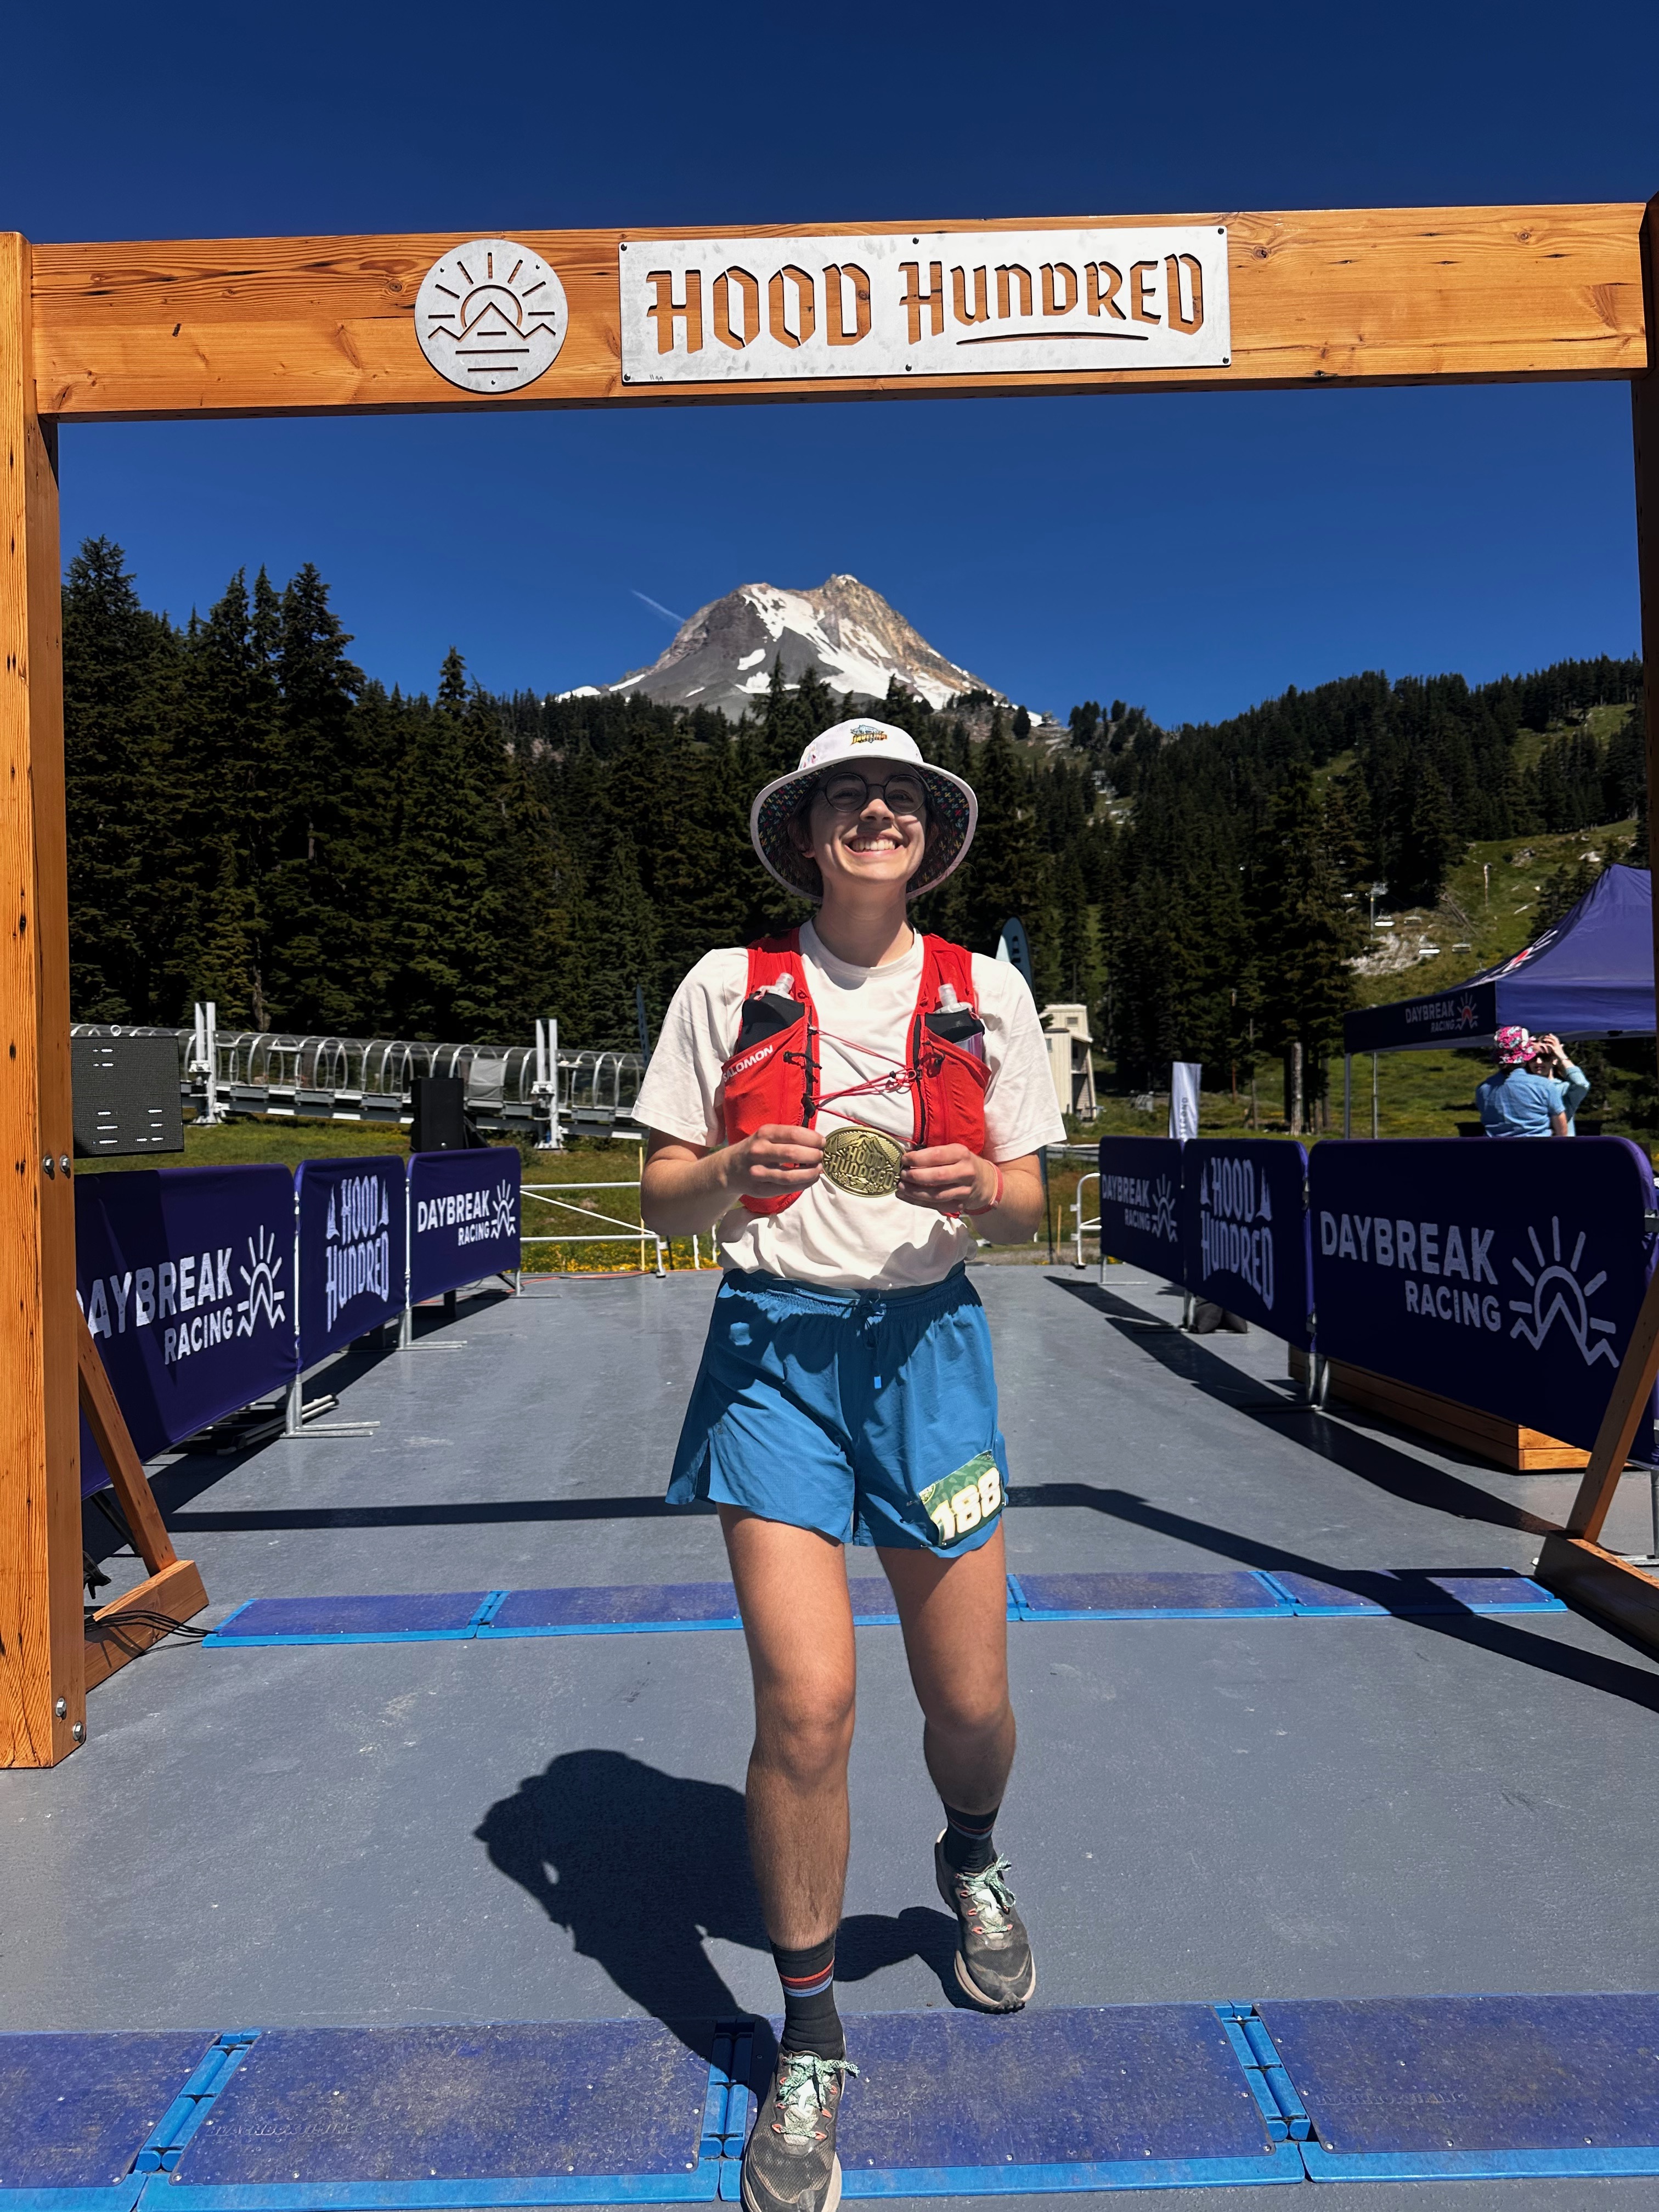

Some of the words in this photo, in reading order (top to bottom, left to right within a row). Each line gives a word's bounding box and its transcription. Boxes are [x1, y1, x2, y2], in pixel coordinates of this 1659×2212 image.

[646, 262, 871, 355] HOOD
[1405, 1000, 1454, 1024] DAYBREAK
[1431, 1020, 1455, 1033] RACING
[723, 1044, 774, 1082] SALOMON
[846, 1145, 886, 1169] HOOD
[341, 1175, 379, 1246] HOOD
[417, 1189, 490, 1233] DAYBREAK
[1102, 1174, 1150, 1207] DAYBREAK
[1211, 1156, 1255, 1223] HOOD
[458, 1221, 490, 1246] RACING
[1124, 1208, 1151, 1232] RACING
[1320, 1210, 1499, 1285] DAYBREAK
[76, 1247, 233, 1339] AYBREAK
[1404, 1280, 1502, 1332] RACING
[165, 1306, 233, 1365] RACING
[930, 1467, 1001, 1542] 188
